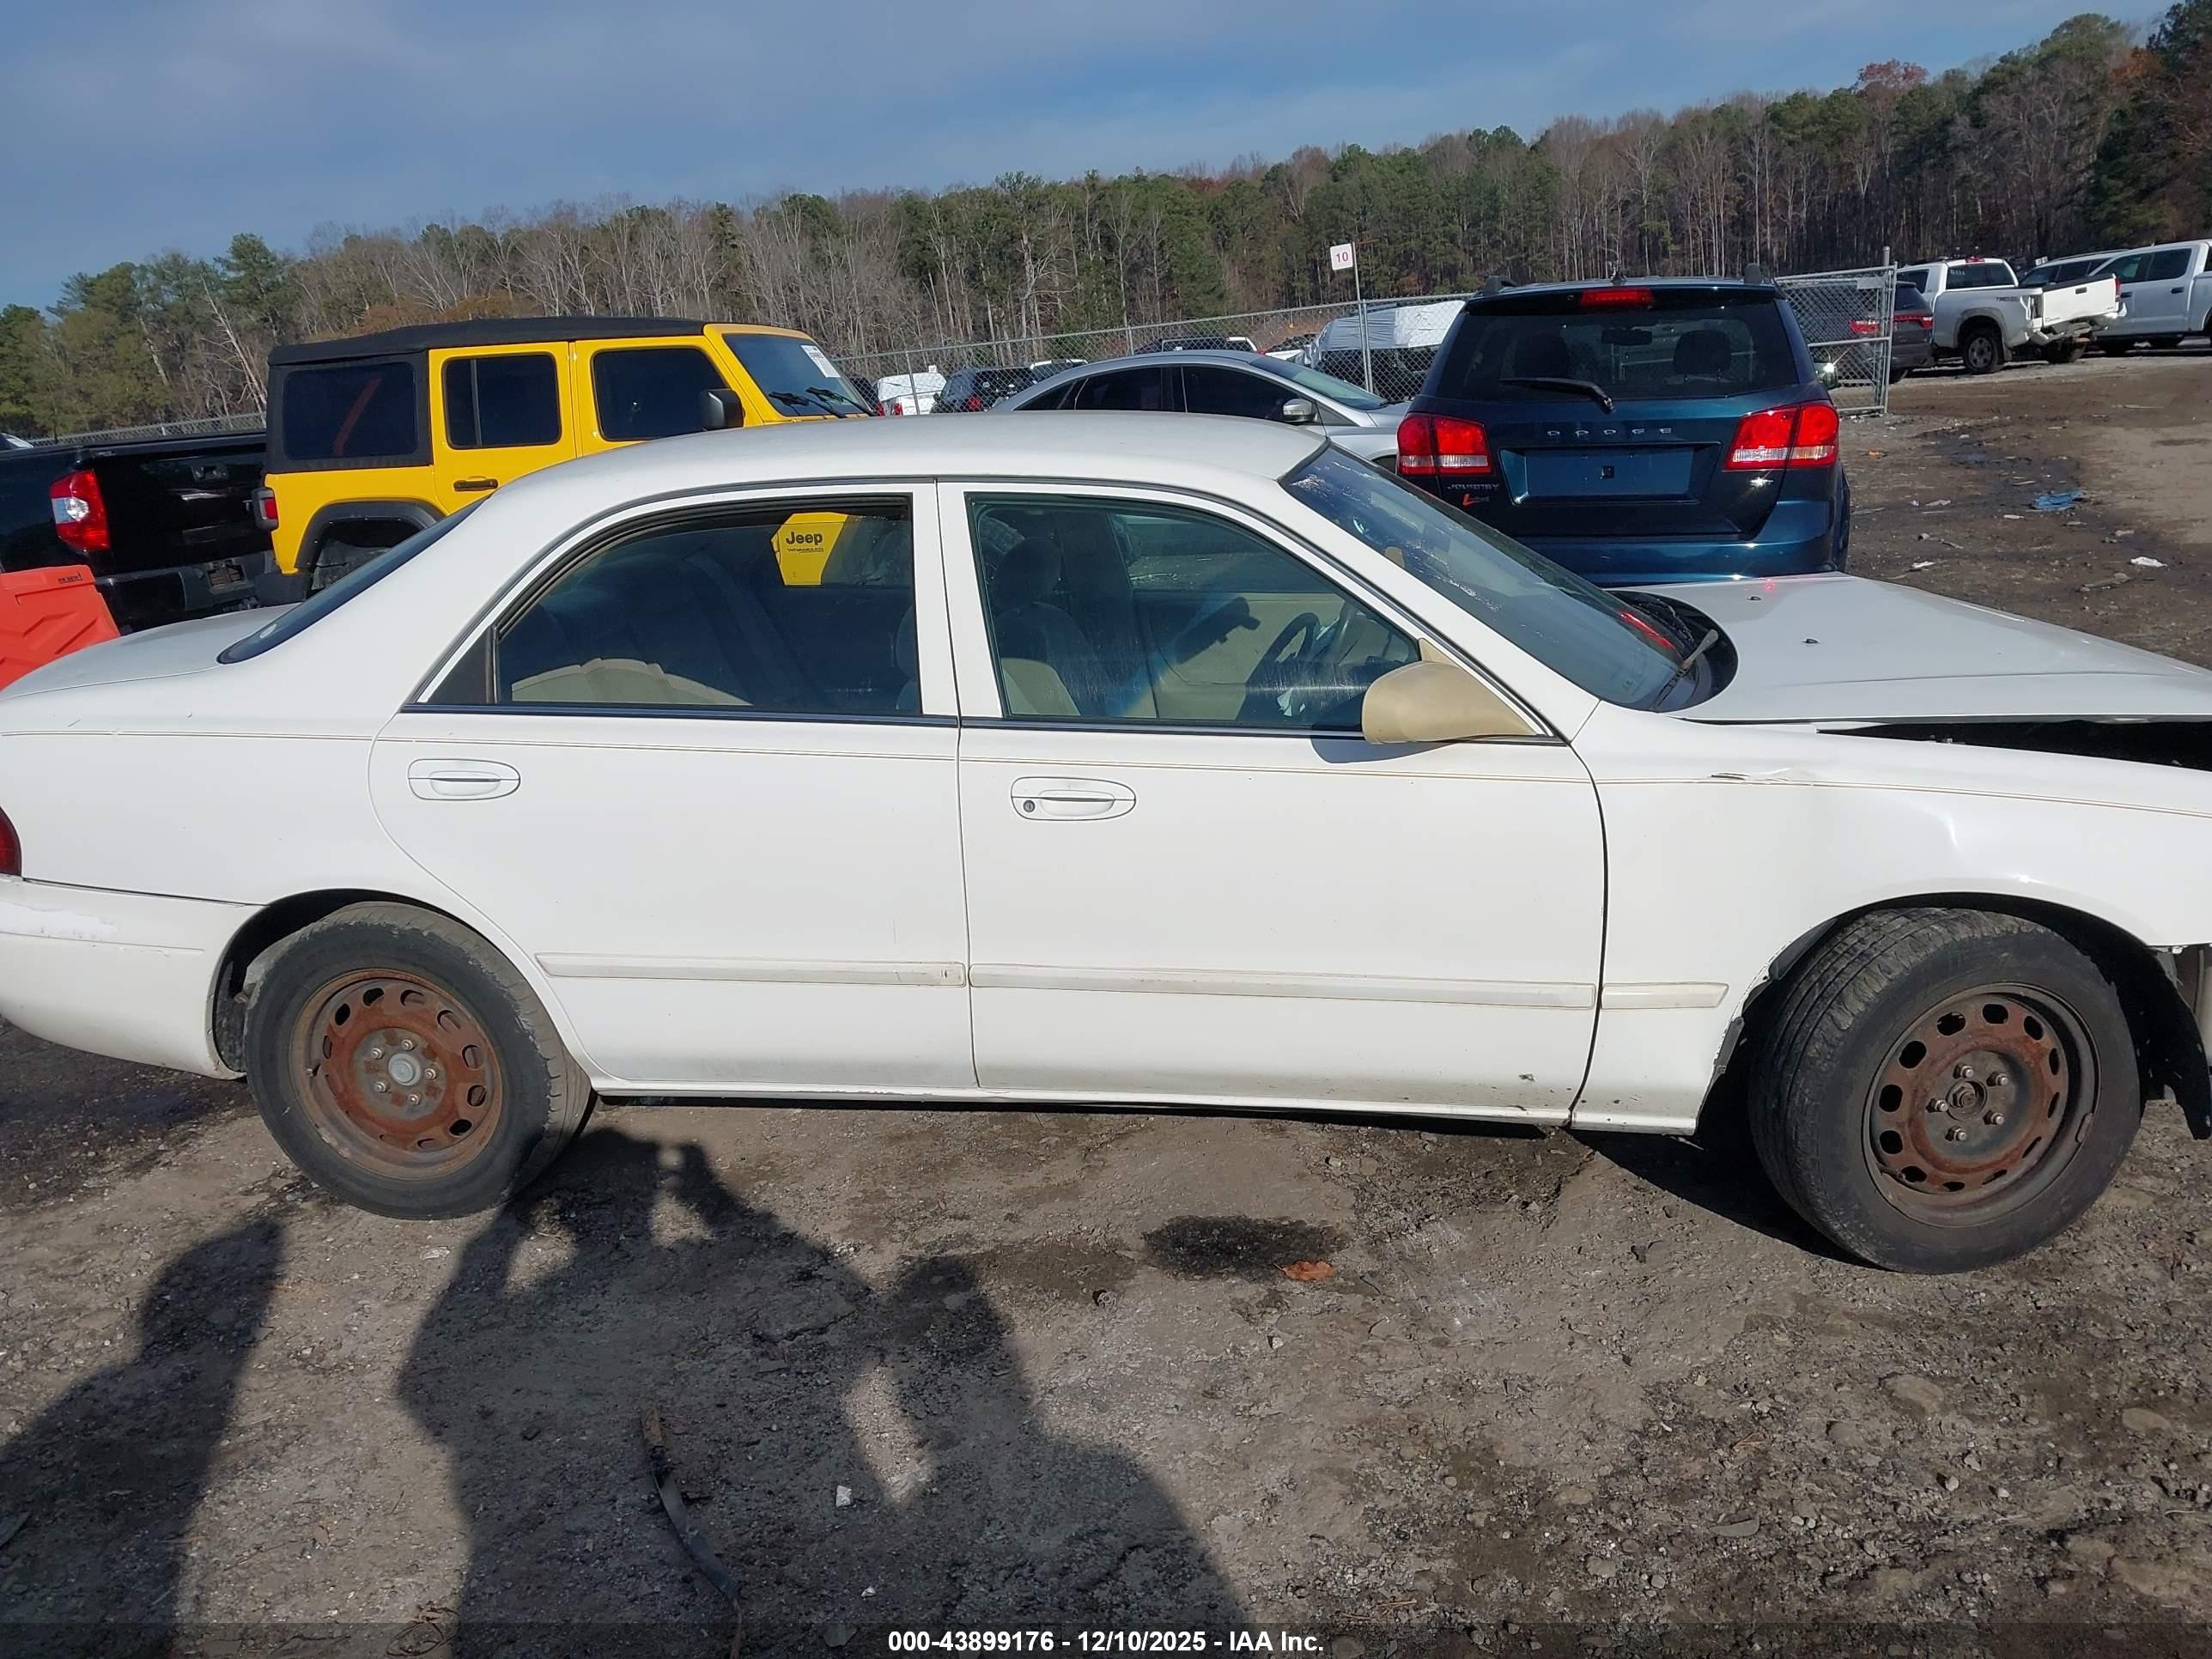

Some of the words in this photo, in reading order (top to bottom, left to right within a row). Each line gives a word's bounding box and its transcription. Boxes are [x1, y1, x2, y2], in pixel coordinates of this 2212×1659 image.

[1335, 252, 1349, 264] 10
[1547, 428, 1672, 437] DODGE
[785, 531, 823, 546] Jeep
